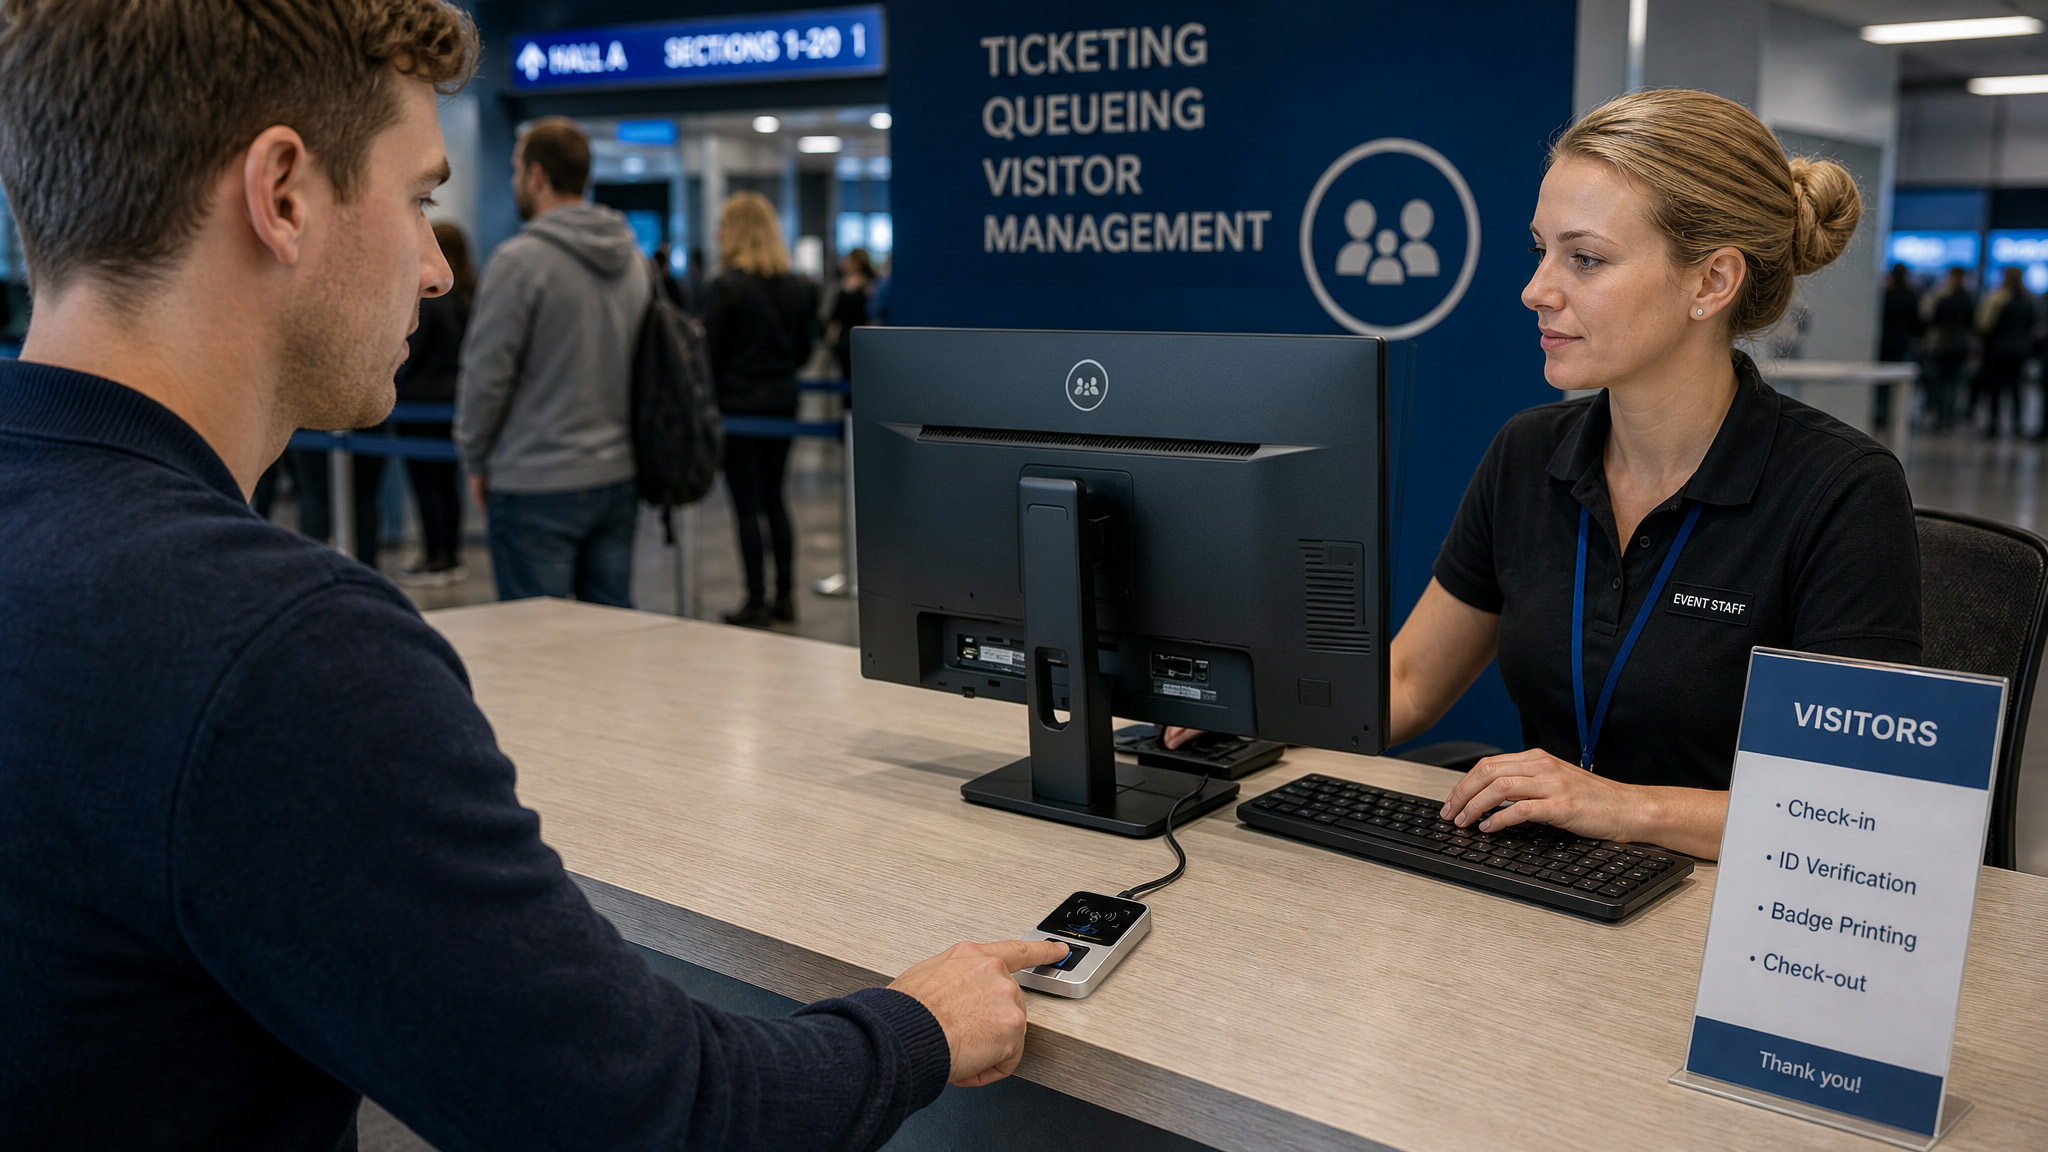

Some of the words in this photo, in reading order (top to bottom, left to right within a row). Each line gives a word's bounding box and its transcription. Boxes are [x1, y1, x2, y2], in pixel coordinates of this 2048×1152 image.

[604, 40, 629, 72] A
[664, 30, 781, 69] SECTIONS
[783, 26, 842, 61] 1-20
[980, 22, 1208, 77] TICKETING
[982, 86, 1206, 142] QUEUEING
[982, 154, 1143, 197] VISITOR
[983, 210, 1272, 253] MANAGEMENT
[1673, 593, 1710, 609] EVENT
[1710, 599, 1746, 615] STAFF
[1794, 701, 1938, 747] VISITORS
[1788, 799, 1876, 832] Check-in
[1779, 850, 1800, 871] ID
[1806, 856, 1917, 895] Verification
[1771, 901, 1833, 933] Badge
[1839, 915, 1917, 953] Printing
[1763, 952, 1868, 993] Check-out
[1759, 1050, 1815, 1082] Thank
[1819, 1070, 1862, 1095] you!
